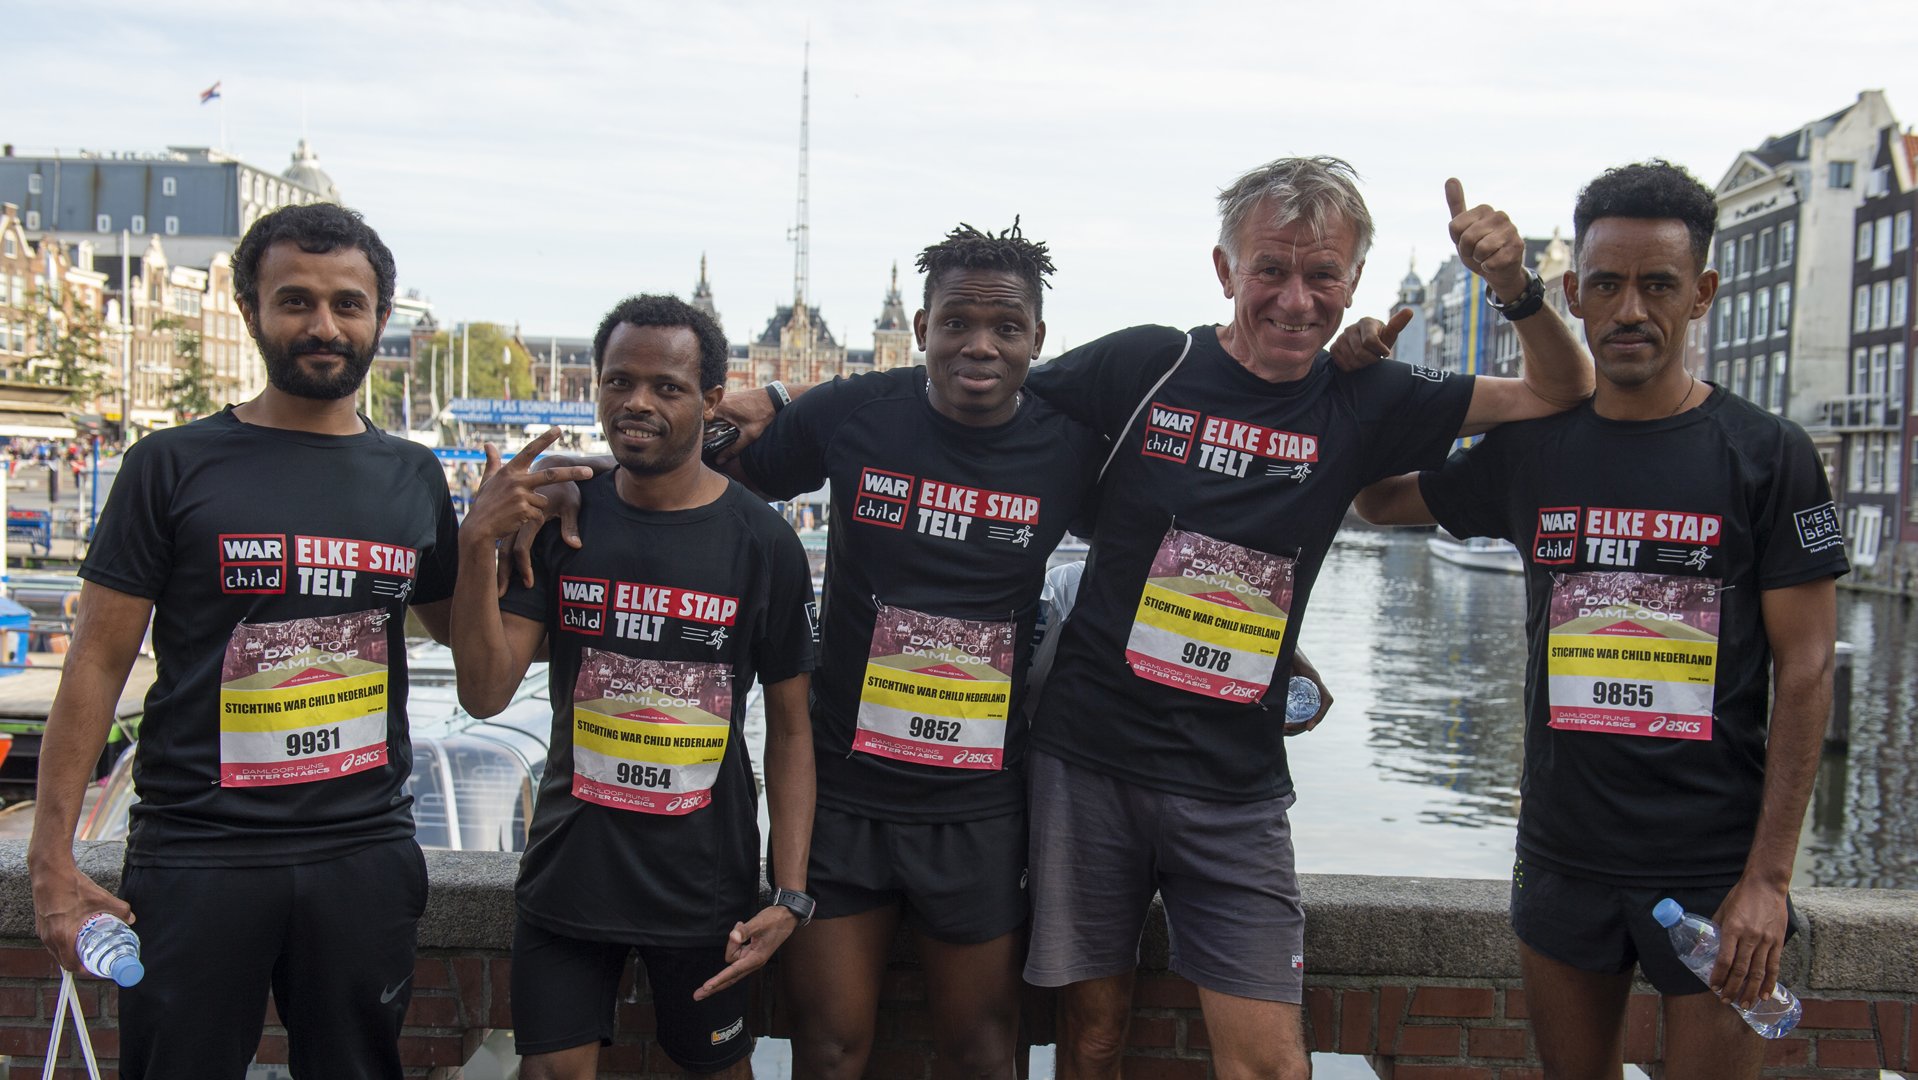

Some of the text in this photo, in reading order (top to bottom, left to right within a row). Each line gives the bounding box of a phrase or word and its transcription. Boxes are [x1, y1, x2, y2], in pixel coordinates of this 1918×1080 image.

[1152, 408, 1194, 433] WAR
[1146, 434, 1186, 457] child
[1202, 419, 1316, 459] ELKE STAP
[1197, 444, 1254, 478] TELT
[865, 473, 909, 498] WAR
[858, 501, 902, 523] child
[920, 481, 1038, 521] ELKE STAP
[917, 508, 972, 541] TELT
[1541, 513, 1576, 532] WAR
[1586, 510, 1719, 542] ELKE STAP
[224, 541, 282, 560] WAR
[297, 538, 416, 573] ELKE STAP
[1537, 537, 1572, 559] child
[1585, 538, 1640, 567] TELT
[226, 568, 280, 589] child
[297, 567, 357, 598] TELT
[1182, 568, 1272, 598] DAMLOOP
[1191, 559, 1271, 586] DAM TOT
[562, 581, 604, 603] WAR
[616, 584, 737, 622] ELKE STAP
[1585, 597, 1677, 610] DAM TOT
[564, 609, 601, 629] child
[1144, 596, 1192, 619] STICHTING
[1192, 611, 1214, 625] WAR
[1214, 617, 1239, 632] CHILD
[1239, 623, 1281, 640] NEDERLAND
[1578, 608, 1684, 622] DAMLOOP
[615, 611, 665, 642] TELT
[265, 640, 351, 659] DAM TOT
[902, 645, 991, 665] DAMLOOP
[910, 635, 988, 654] DAM TOT
[258, 650, 359, 672] DAMLOOP
[1181, 642, 1232, 673] 9878
[1551, 647, 1712, 666] STICHTING WAR CHILD NEDERLAND
[610, 679, 695, 696] DAM TOT
[1133, 663, 1211, 690] BETTER ON ASICS
[1184, 673, 1208, 683] RUNS
[225, 684, 384, 714] STICHTING WAR CHILD NEDERLAND
[603, 689, 701, 708] DAMLOOP
[867, 675, 1006, 703] STICHTING WAR CHILD NEDERLAND
[1592, 681, 1653, 708] 9855
[909, 716, 961, 742] 9852
[1602, 714, 1631, 722] RUNS
[1605, 721, 1636, 729] ASICS
[1665, 721, 1701, 733] asics
[286, 727, 340, 756] 9931
[577, 720, 724, 748] STICHTING WAR CHILD NEDERLAND
[355, 749, 379, 766] asics
[865, 741, 944, 761] BETTER ON ASICS
[915, 746, 939, 754] RUNS
[967, 753, 993, 763] asics
[236, 768, 330, 781] BETTER ON ASICS
[297, 763, 324, 771] RUNS
[617, 762, 671, 789] 9854
[625, 793, 650, 802] RUNS
[627, 799, 655, 808] ASICS
